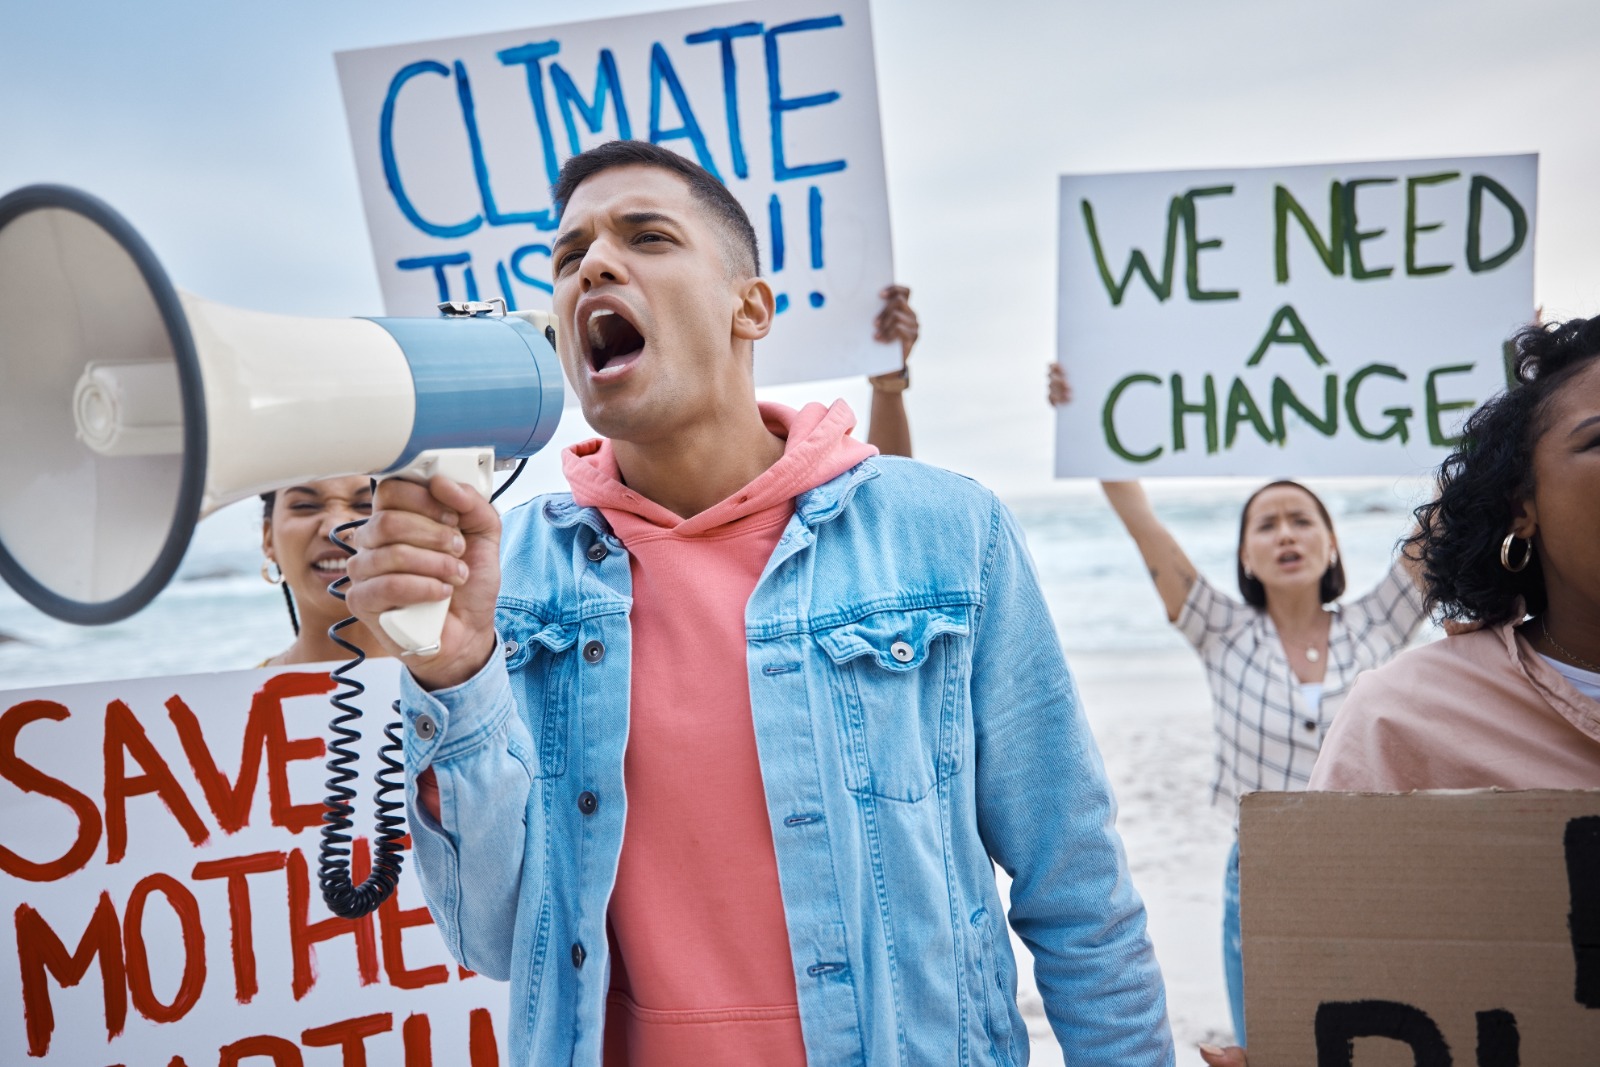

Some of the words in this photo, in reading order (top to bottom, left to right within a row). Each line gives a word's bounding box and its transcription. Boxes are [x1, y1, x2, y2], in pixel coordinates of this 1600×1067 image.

[379, 14, 847, 239] CLIMATE
[1081, 185, 1240, 306] WE
[1274, 172, 1528, 284] NEED
[1246, 304, 1330, 367] A
[0, 671, 350, 882] SAVE
[15, 832, 478, 1058] MOTHE
